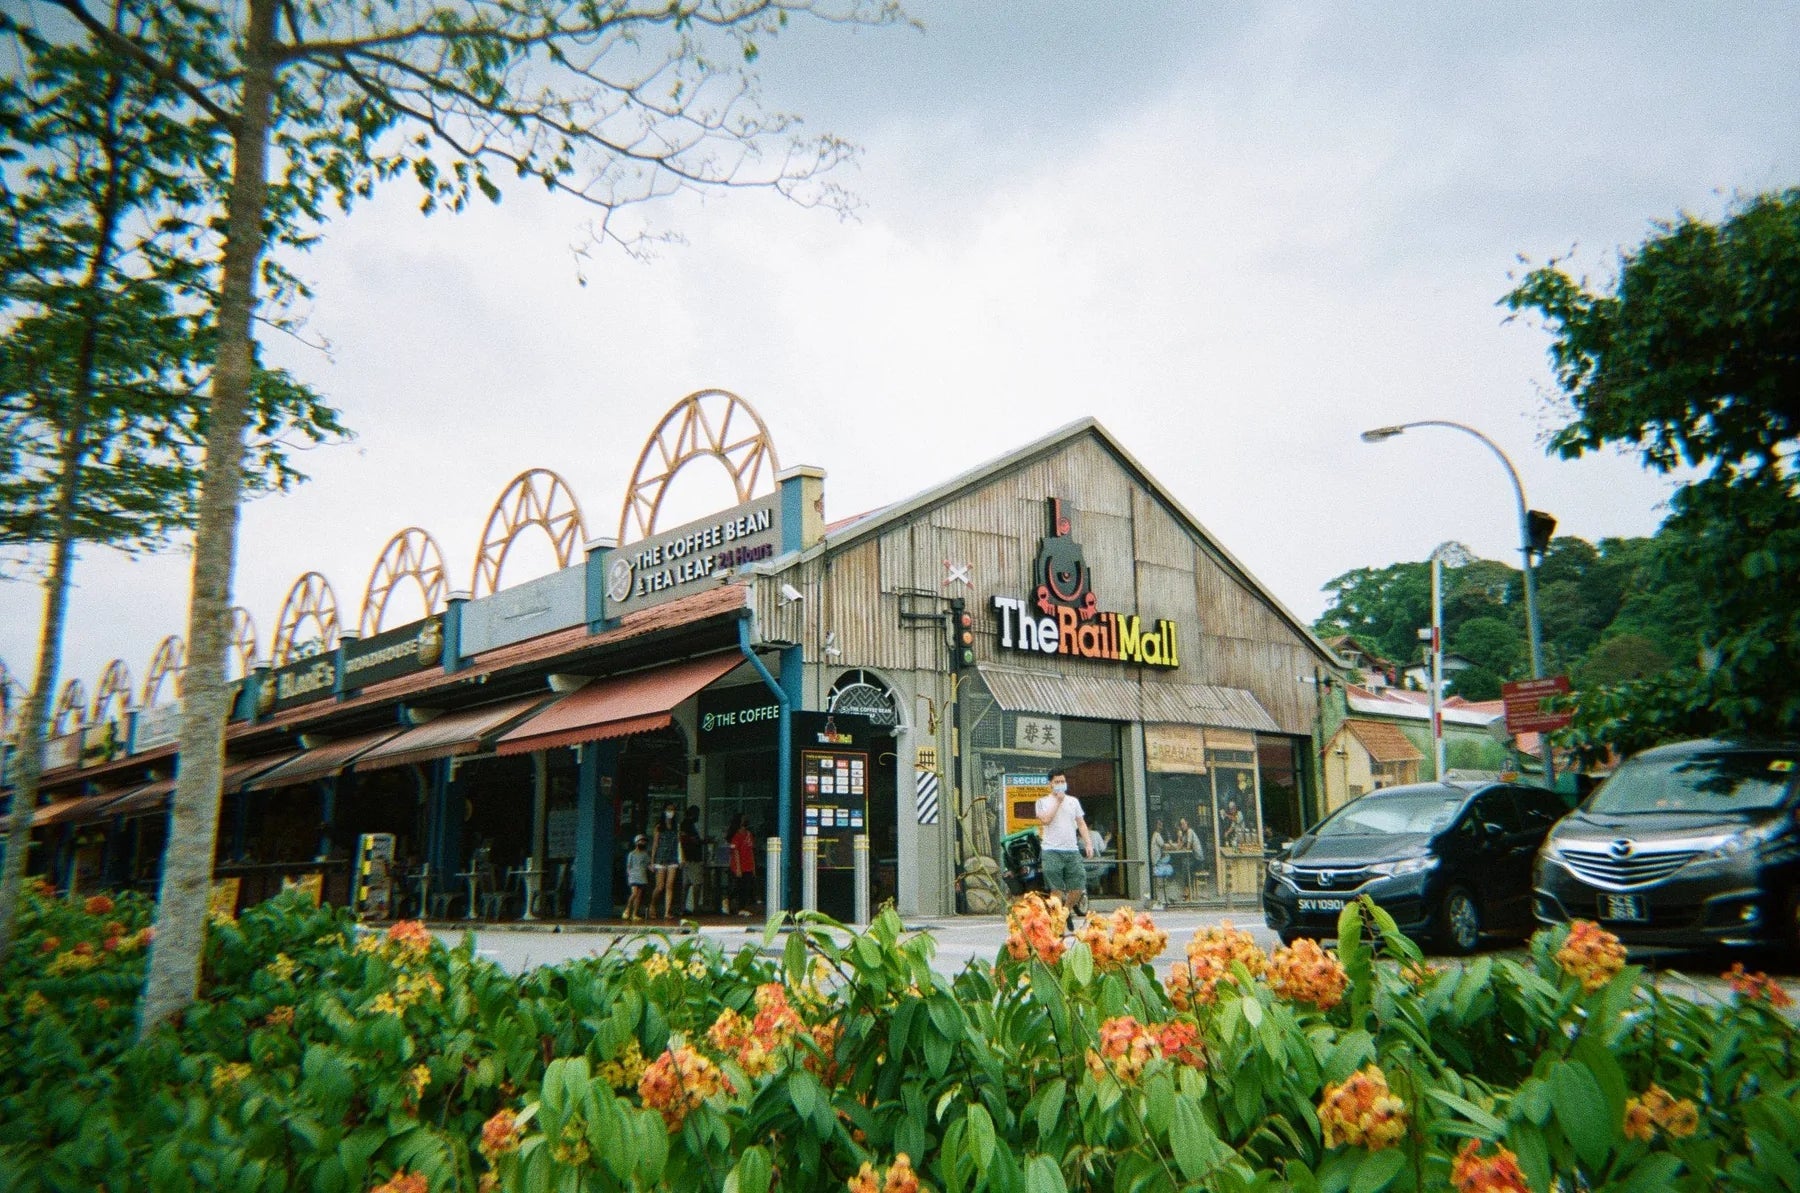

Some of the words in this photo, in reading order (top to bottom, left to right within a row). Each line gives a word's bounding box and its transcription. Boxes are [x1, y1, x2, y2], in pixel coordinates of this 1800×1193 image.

[635, 546, 661, 570] THE
[665, 525, 721, 561] COFFEE
[725, 509, 771, 541] BEAN
[718, 550, 734, 569] 24
[735, 543, 772, 563] Hours
[647, 570, 674, 592] TEA
[678, 555, 715, 583] LEAF
[716, 712, 736, 727] THE
[739, 705, 780, 724] COFFEE
